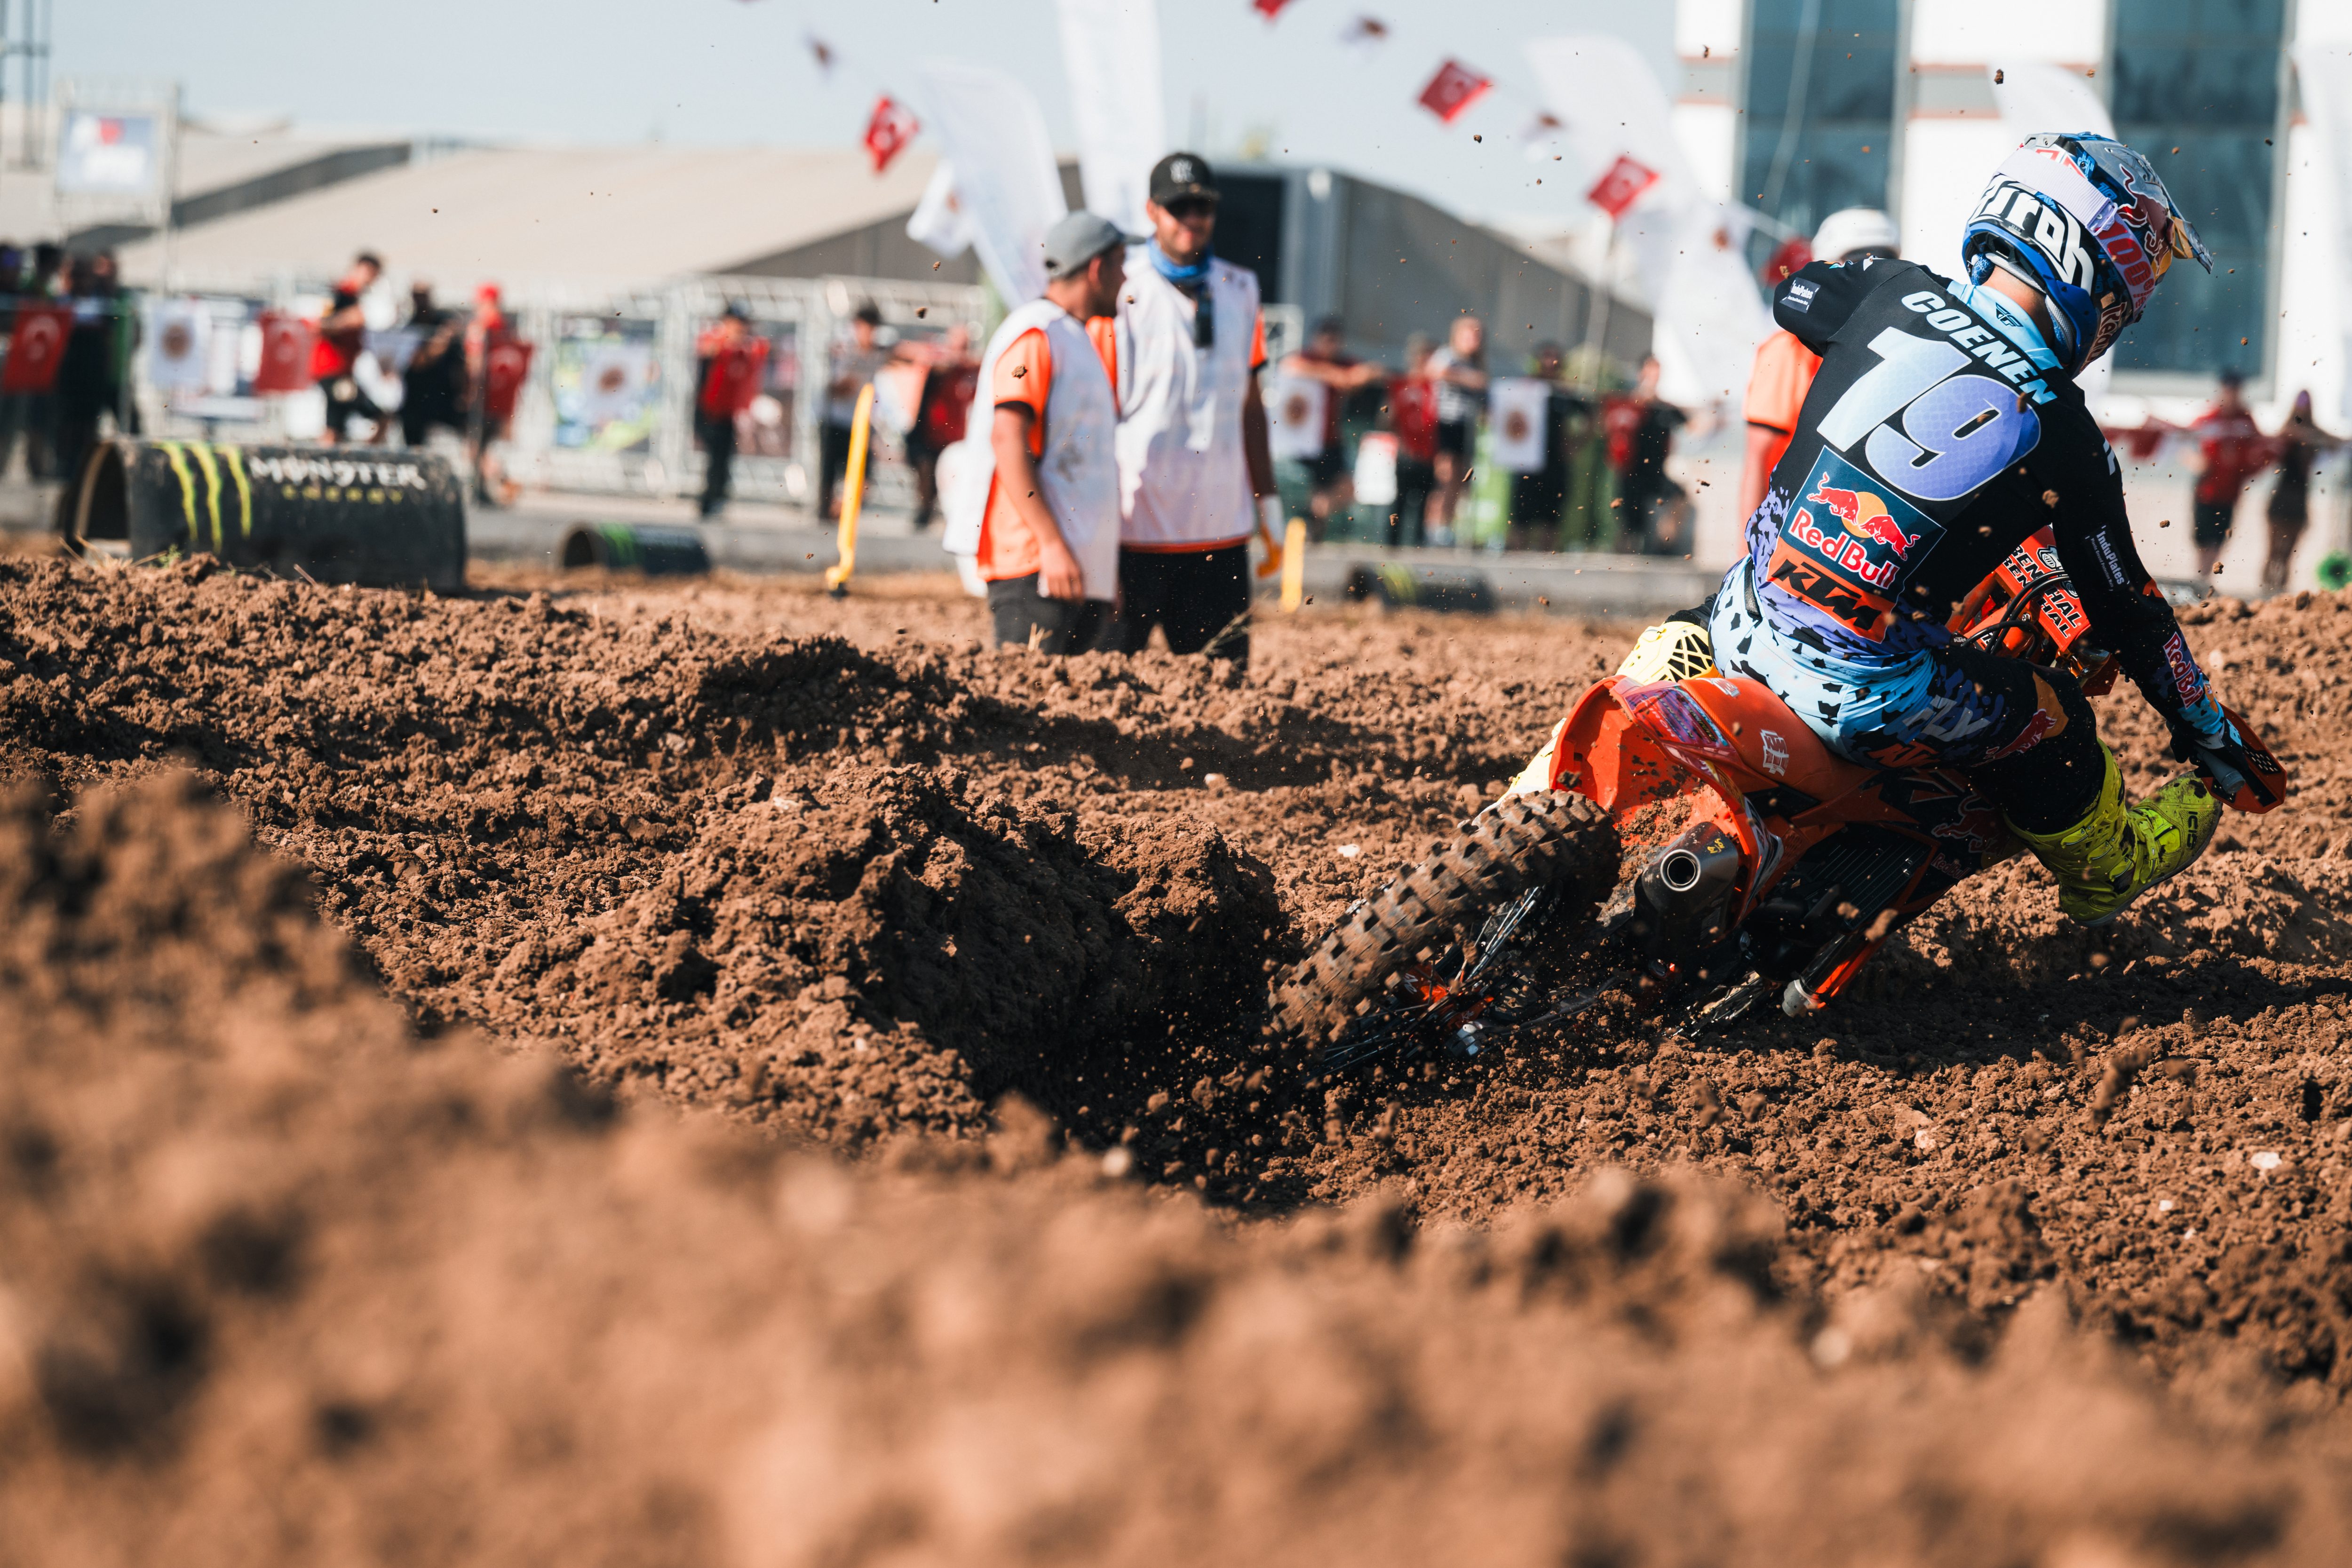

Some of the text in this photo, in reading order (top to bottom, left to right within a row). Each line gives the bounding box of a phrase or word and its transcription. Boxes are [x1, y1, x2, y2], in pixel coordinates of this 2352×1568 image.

[1901, 291, 2058, 405] COENEN
[1817, 326, 2041, 501] 19
[249, 455, 427, 490] MONSTER
[2096, 531, 2124, 585] InduPlates
[1772, 559, 1882, 631] KTM
